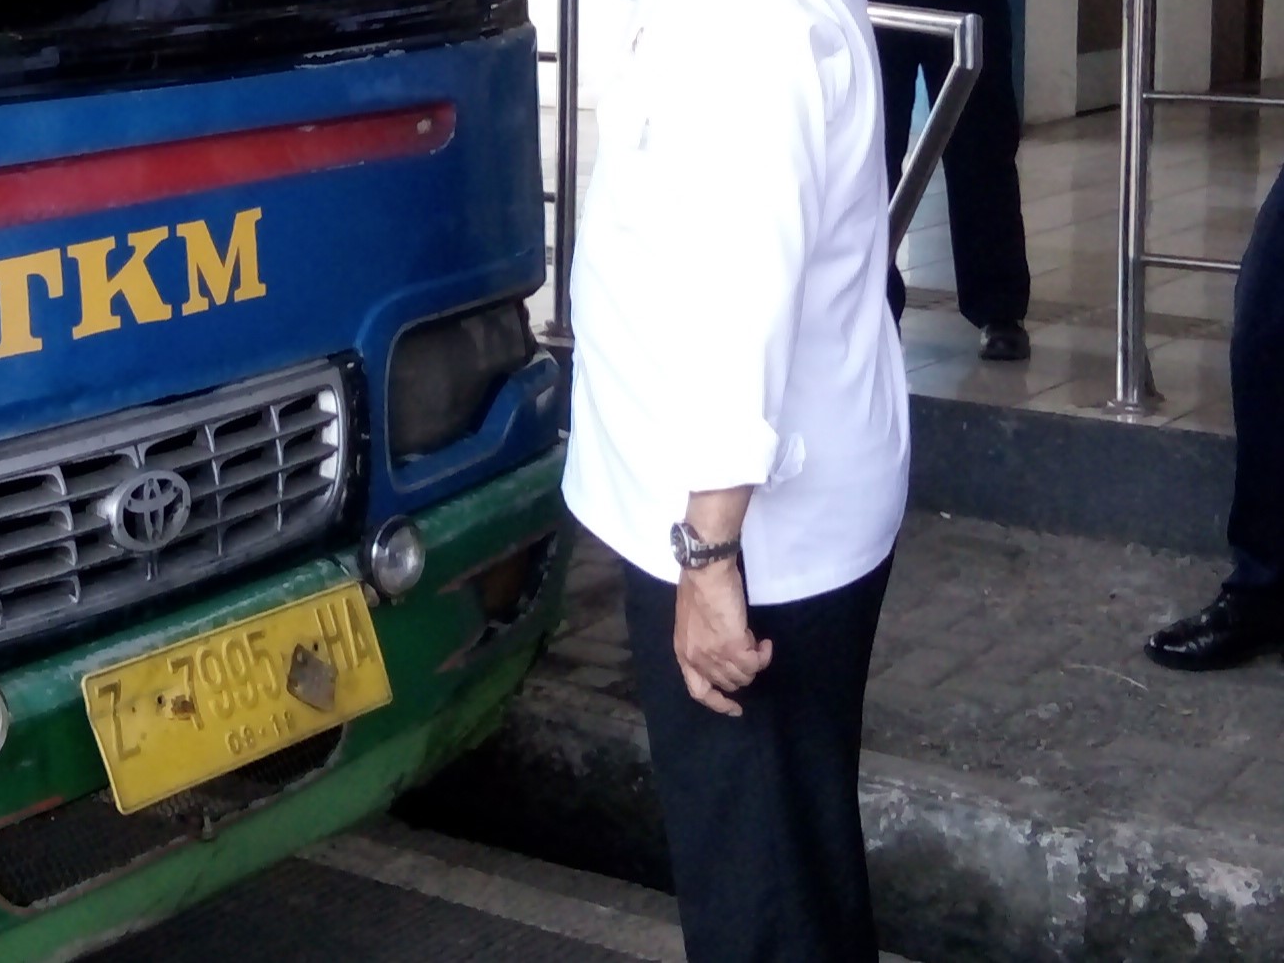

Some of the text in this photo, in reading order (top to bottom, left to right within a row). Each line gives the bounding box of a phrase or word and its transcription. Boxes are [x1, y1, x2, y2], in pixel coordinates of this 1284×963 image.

[94, 597, 375, 762] Z 7995 HA
